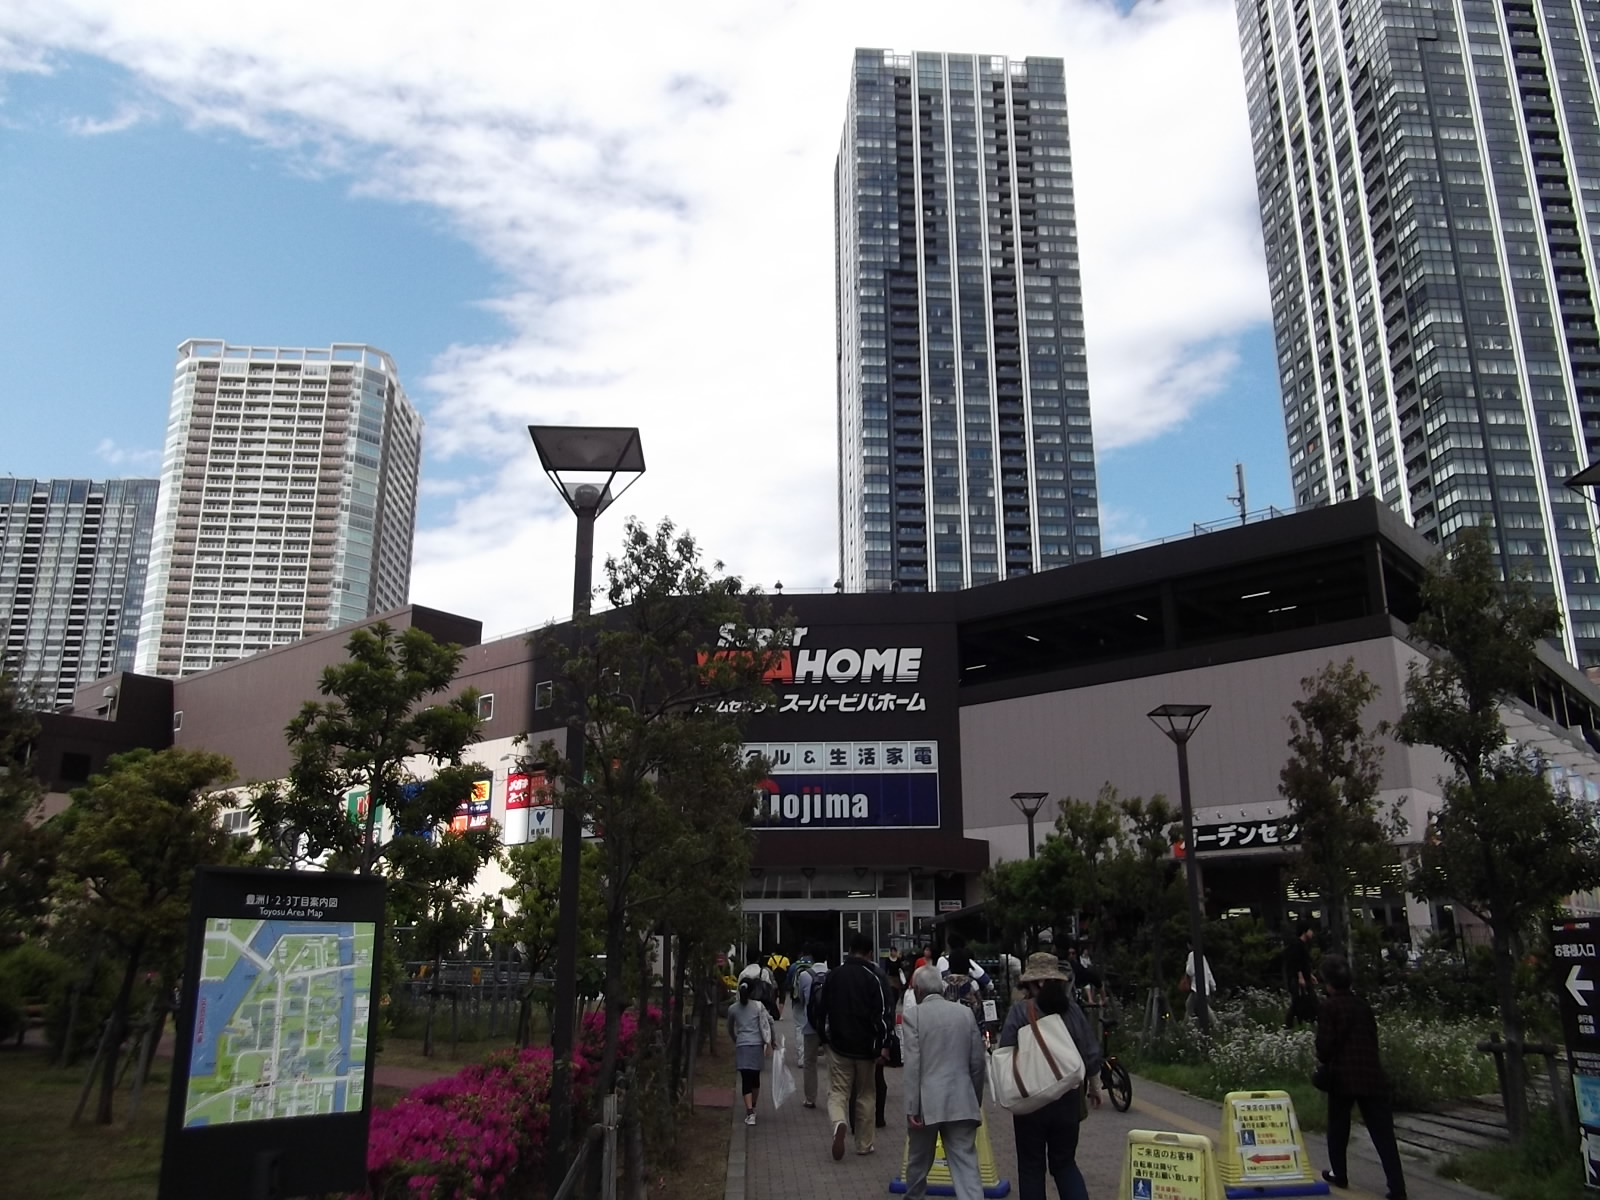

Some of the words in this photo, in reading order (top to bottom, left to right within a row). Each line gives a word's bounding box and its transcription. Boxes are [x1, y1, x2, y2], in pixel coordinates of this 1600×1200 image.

[696, 647, 923, 684] VAHOME
[779, 692, 927, 713] スーパービバホーム
[260, 906, 286, 918] Toyosu
[287, 908, 305, 916] Area
[307, 909, 323, 919] Map
[1136, 1147, 1194, 1161] ご来店のお客様
[1133, 1160, 1178, 1172] 自転車は降りて
[1135, 1169, 1200, 1183] 通行をお願い致します
